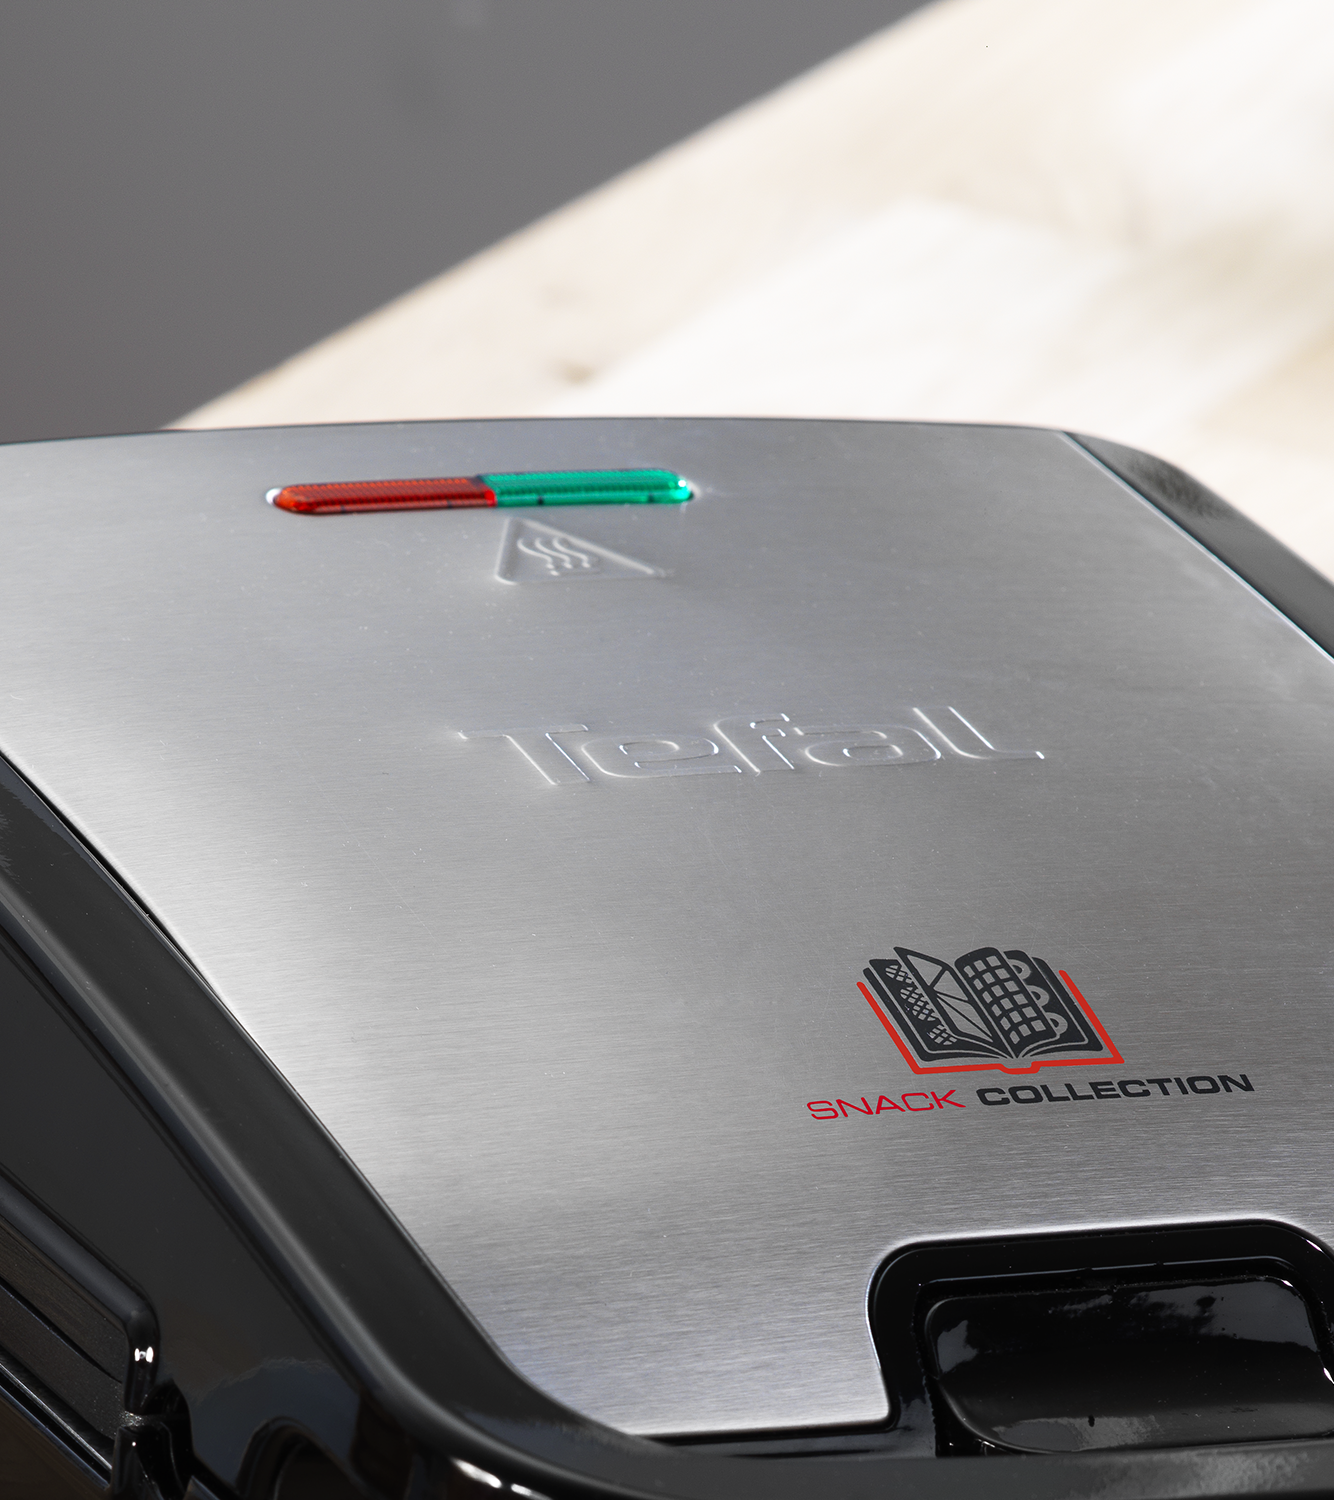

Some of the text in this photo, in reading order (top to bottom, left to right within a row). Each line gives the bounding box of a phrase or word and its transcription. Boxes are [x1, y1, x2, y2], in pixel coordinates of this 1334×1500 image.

[455, 704, 1046, 788] Tefal
[806, 1073, 1255, 1120] SNACK COLLECTION
